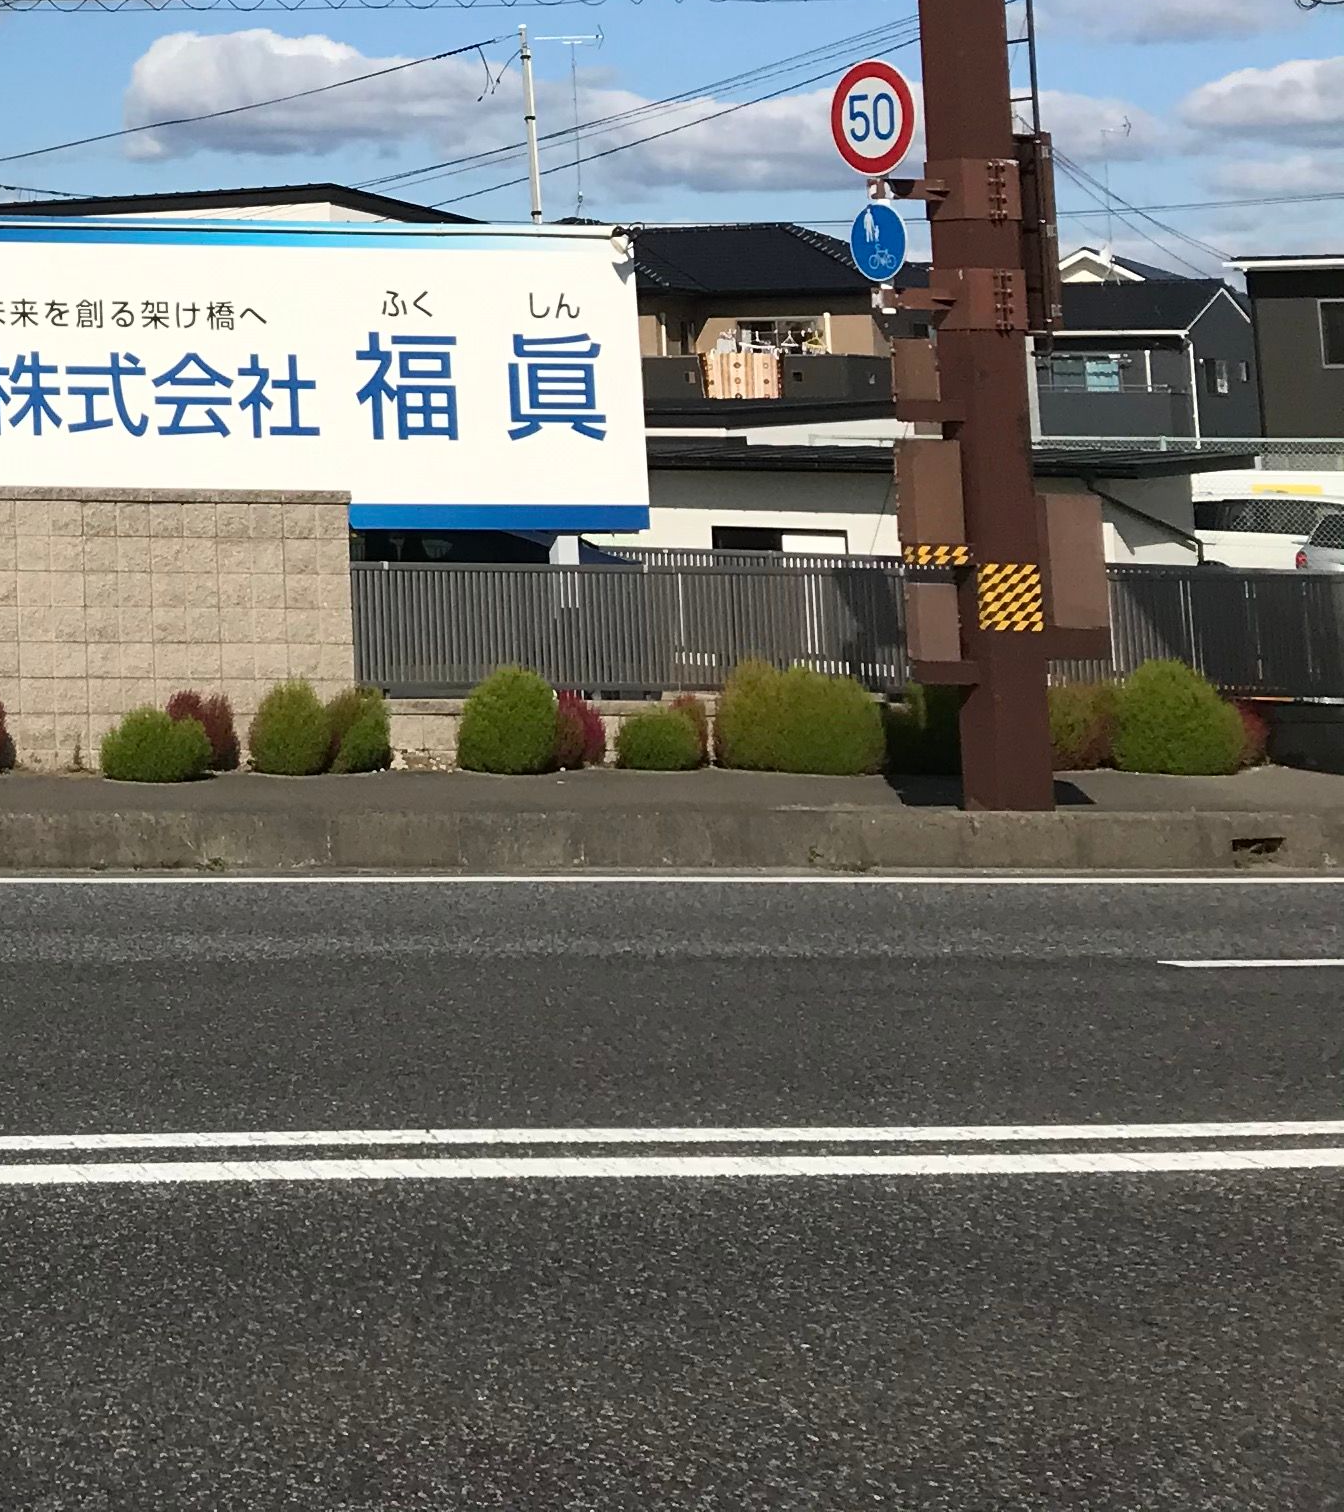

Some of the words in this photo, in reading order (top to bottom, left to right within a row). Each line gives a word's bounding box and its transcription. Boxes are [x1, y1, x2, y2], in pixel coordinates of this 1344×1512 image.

[848, 92, 896, 143] 50
[381, 290, 433, 318] ふく
[528, 292, 581, 319] しん
